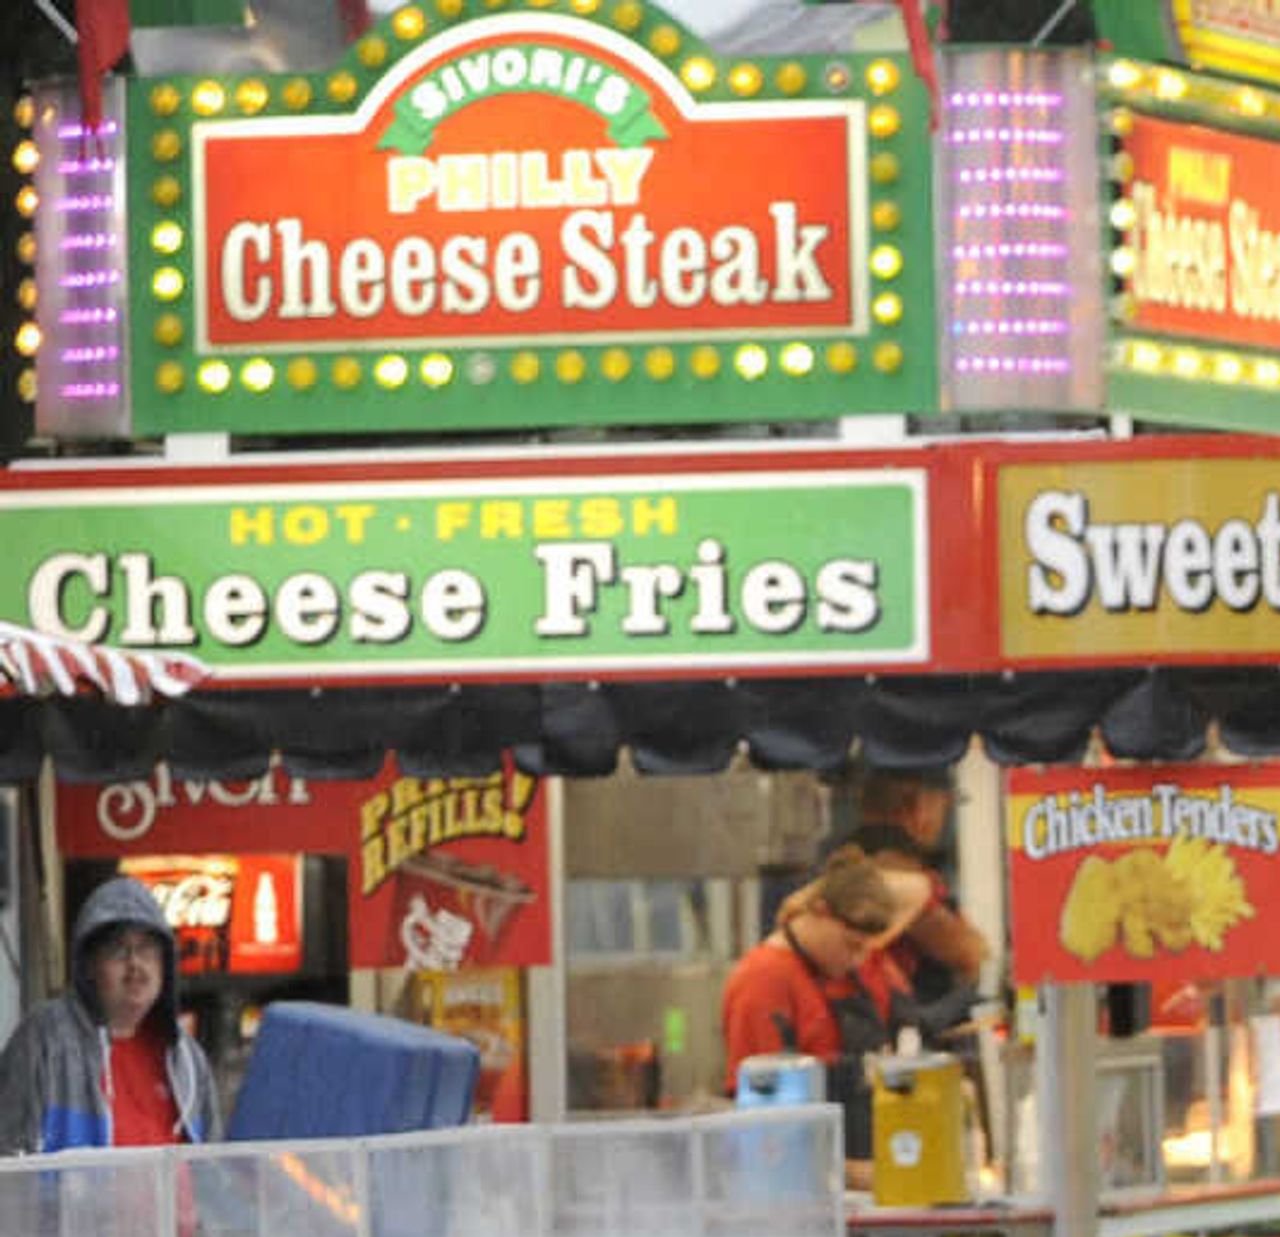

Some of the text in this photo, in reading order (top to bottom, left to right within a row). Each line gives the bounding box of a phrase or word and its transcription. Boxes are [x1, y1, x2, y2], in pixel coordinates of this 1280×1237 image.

[411, 48, 631, 119] SIVORI'S
[387, 148, 654, 213] PHILLY
[221, 200, 833, 321] Cheese Steak
[230, 496, 679, 544] HOT FRESH
[28, 538, 881, 647] Cheese Fries
[1024, 782, 1279, 860] Chicken Tenders
